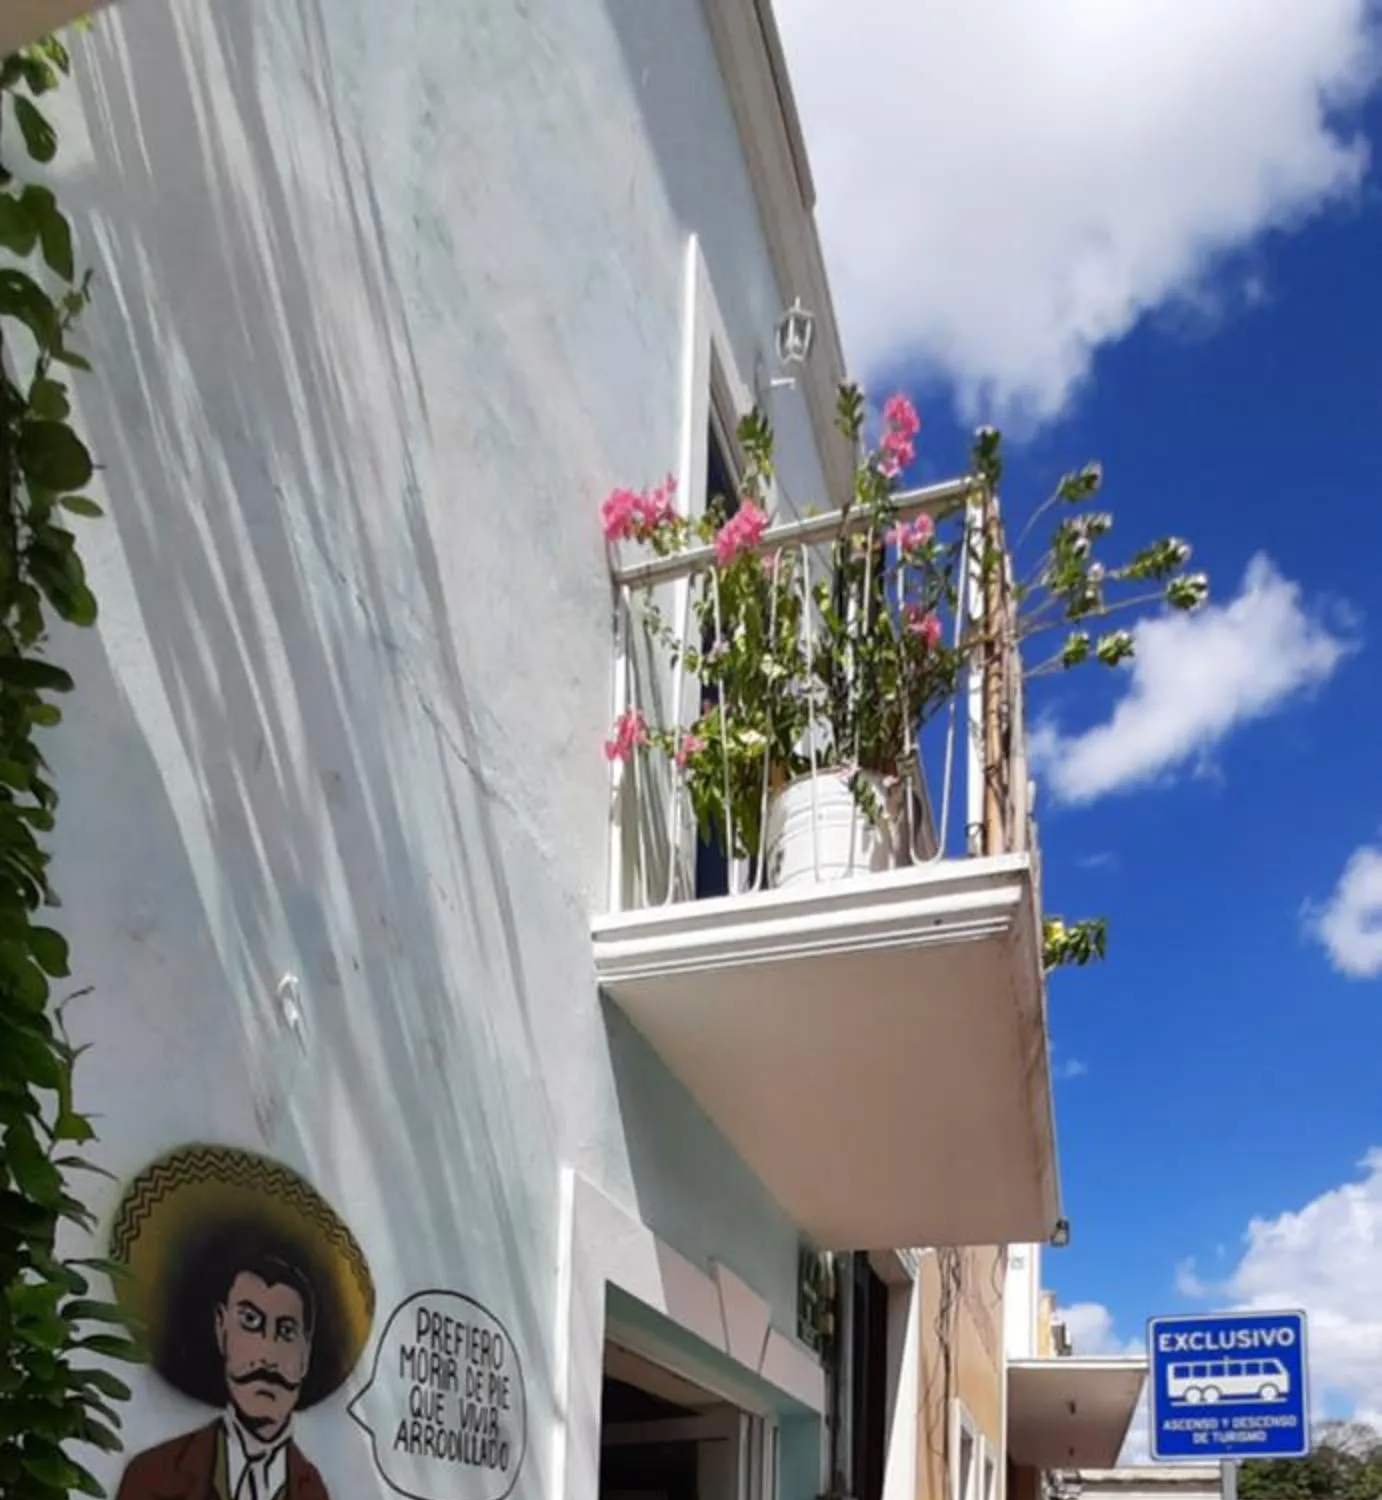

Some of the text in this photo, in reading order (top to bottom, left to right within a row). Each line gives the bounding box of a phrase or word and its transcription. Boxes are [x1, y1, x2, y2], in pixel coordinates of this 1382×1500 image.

[415, 1306, 505, 1371] PREFIERO
[1158, 1326, 1296, 1353] EXCLUSIVO
[399, 1343, 511, 1412] MORIR DE PIE
[409, 1384, 500, 1437] QUE VIVIR
[1221, 1416, 1231, 1429] Y
[393, 1418, 510, 1473] ARRODILLADO
